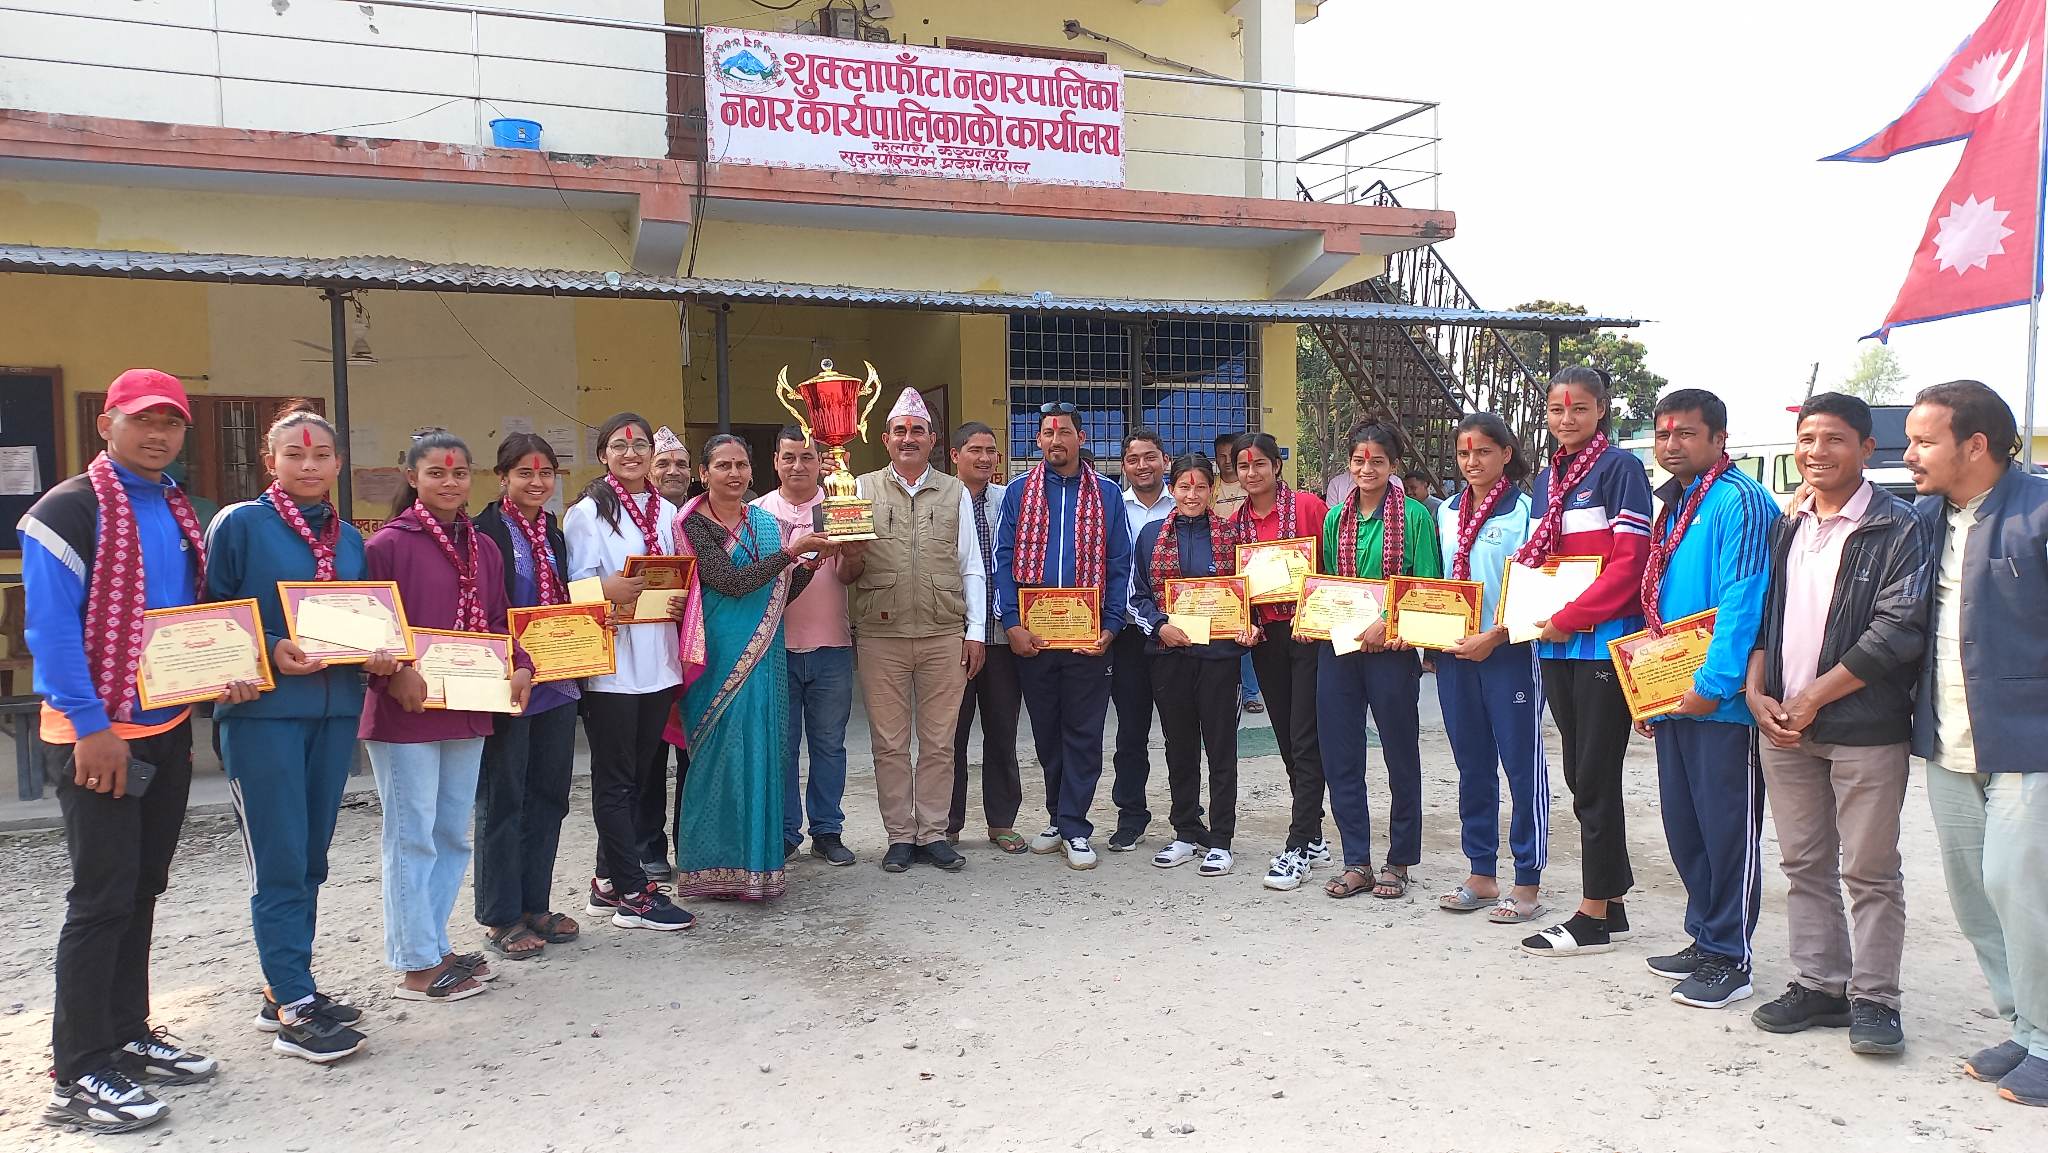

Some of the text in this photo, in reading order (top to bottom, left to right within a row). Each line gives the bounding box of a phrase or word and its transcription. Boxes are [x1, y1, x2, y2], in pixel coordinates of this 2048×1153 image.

[783, 52, 1120, 112] शुक्लाफाँटा नगरपालिका
[720, 93, 1120, 157] नगर कार्यपालिकाको कार्यालय
